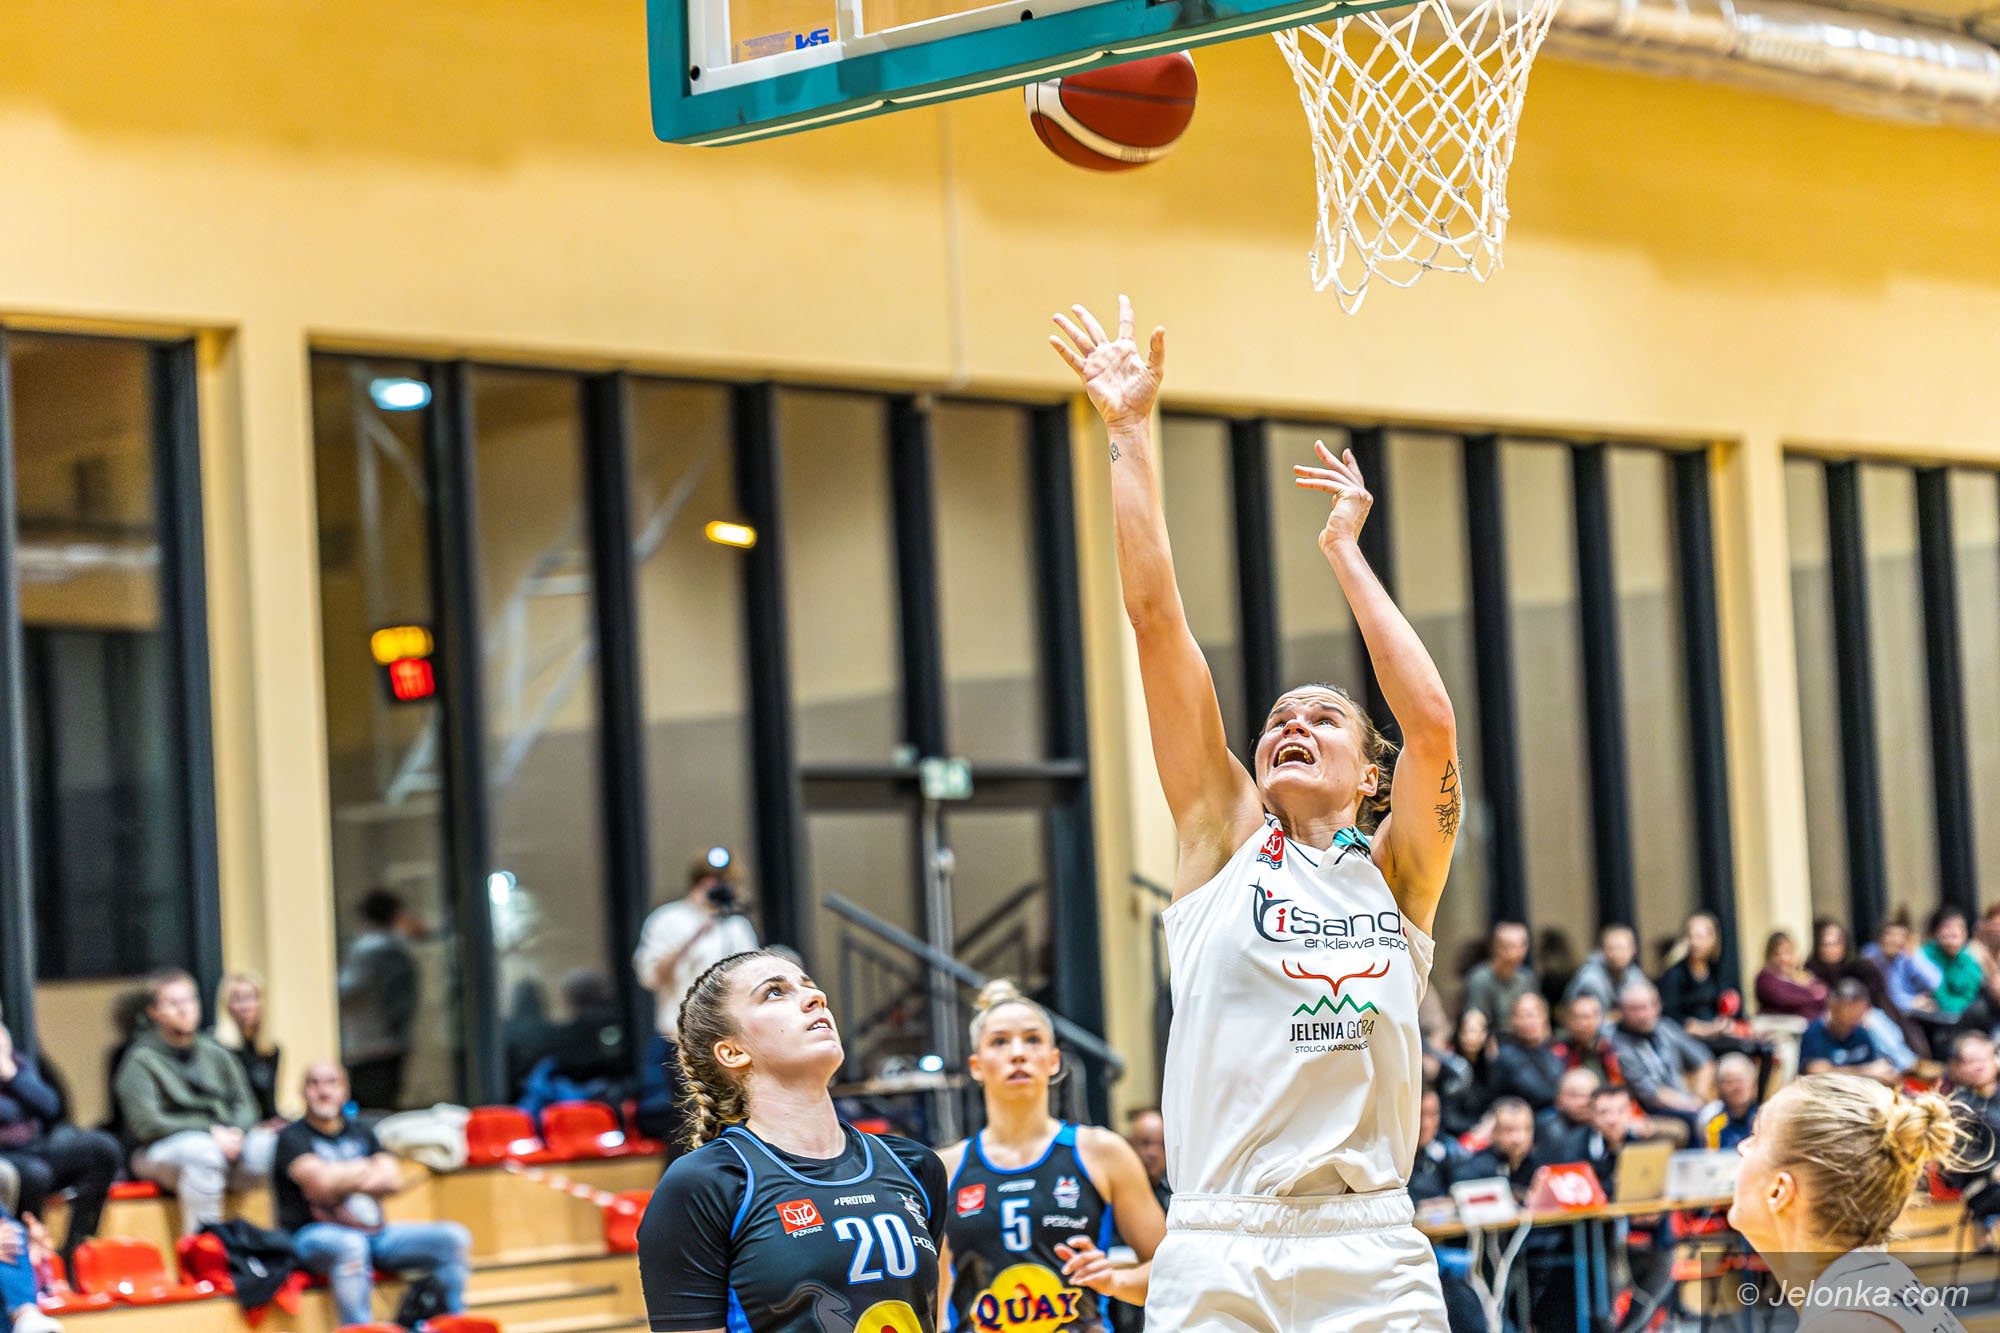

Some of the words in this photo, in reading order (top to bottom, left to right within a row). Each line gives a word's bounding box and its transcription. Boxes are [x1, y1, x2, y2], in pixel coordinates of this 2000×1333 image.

[1304, 937, 1375, 950] enklawa
[1289, 1021, 1344, 1042] JELENIA
[1295, 1045, 1326, 1054] STOLICA
[839, 1194, 876, 1206] PROTON
[1002, 1197, 1032, 1252] 5
[832, 1212, 919, 1285] 20
[976, 1292, 1078, 1331] QUAY
